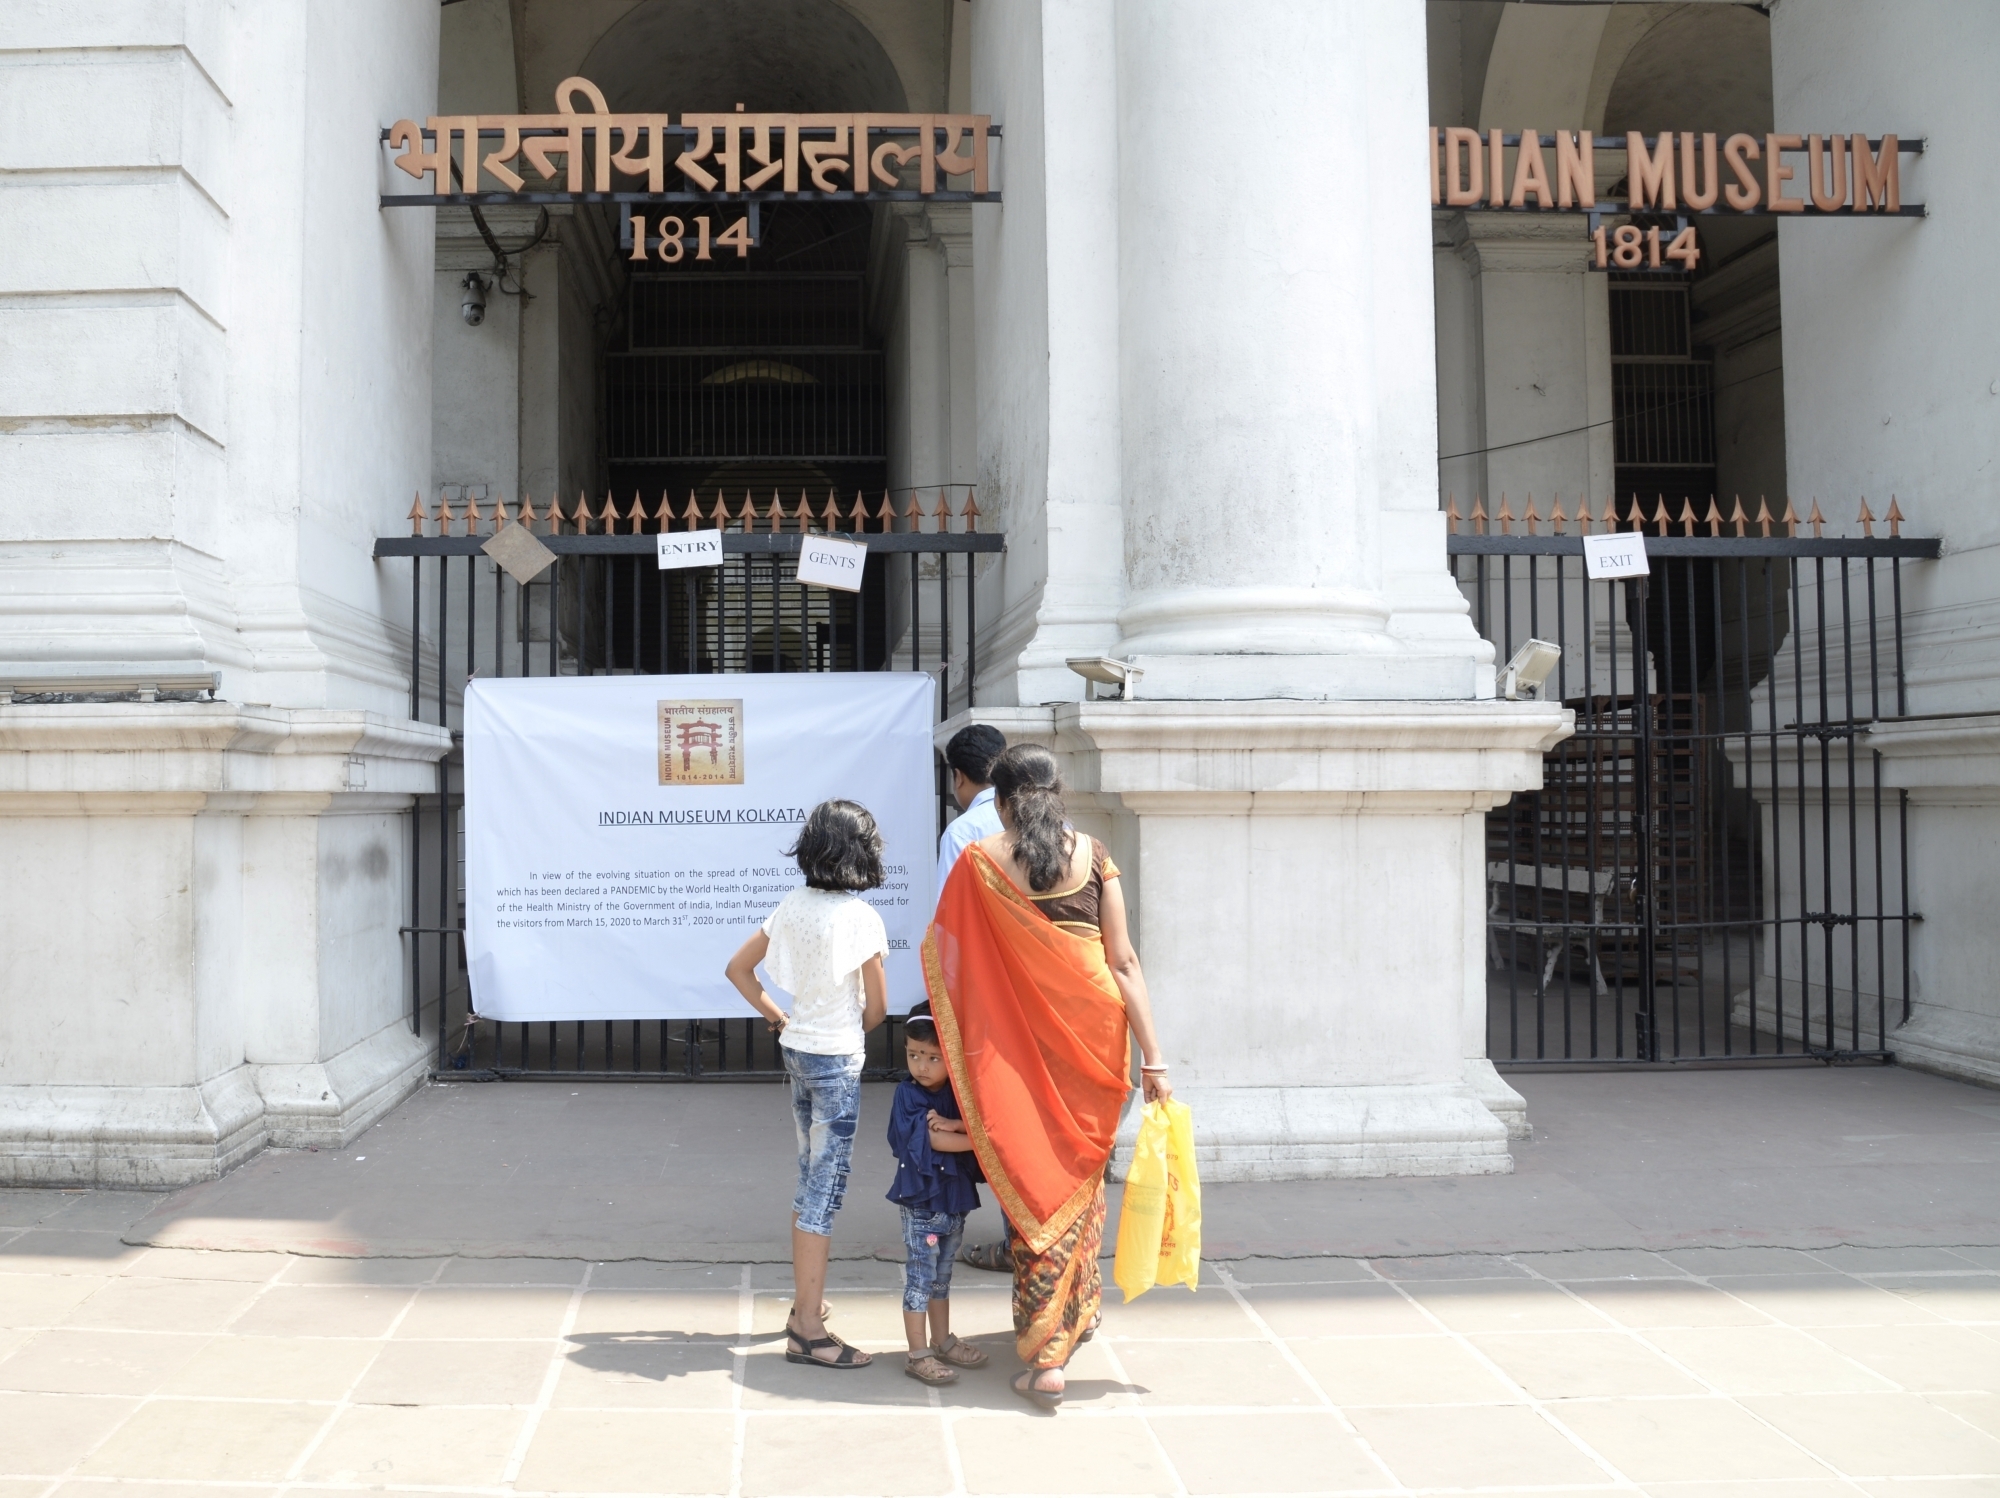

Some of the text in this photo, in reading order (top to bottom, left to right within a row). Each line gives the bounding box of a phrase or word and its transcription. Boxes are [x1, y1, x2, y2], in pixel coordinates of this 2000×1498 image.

[389, 76, 992, 195] भारतीय संग्रहालय
[1429, 126, 1900, 213] DIAN MUSEUM
[628, 215, 754, 263] 1814
[1592, 225, 1700, 270] 1814
[661, 540, 719, 556] ENTRY
[809, 551, 856, 570] GENTS
[1599, 554, 1633, 568] EXIT
[664, 704, 735, 715] भारतीय संग्रहालय
[664, 717, 672, 781] INDIAN MUSEUM
[599, 808, 807, 825] INDIAN MUSEUM KOLKATA
[529, 871, 537, 880] In
[542, 871, 561, 880] view
[565, 871, 574, 879] of
[578, 870, 592, 879] the
[596, 870, 630, 881] evolving
[635, 869, 670, 878] situation
[689, 869, 703, 877] the
[707, 868, 735, 879] spread
[739, 868, 748, 877] of
[752, 868, 780, 876] NOVEL
[784, 866, 804, 876] COR
[883, 865, 909, 875] 2019),
[497, 887, 521, 896] which
[524, 886, 538, 896] has
[541, 886, 561, 895] been
[564, 886, 600, 895] declared
[602, 887, 608, 895] a
[610, 885, 655, 894] PANDEMIC
[657, 885, 667, 896] by
[669, 885, 683, 894] the
[685, 884, 710, 893] World
[713, 884, 740, 893] Health
[742, 883, 795, 895] Organization
[497, 896, 909, 913] of the Health Ministry of the Government of India, Indian Museum closed for
[497, 918, 510, 928] the
[513, 918, 542, 927] visitors
[544, 918, 564, 927] from
[566, 918, 592, 927] March
[595, 917, 607, 928] 15,
[610, 917, 631, 926] 2020
[633, 917, 641, 926] to
[643, 917, 670, 926] March
[693, 916, 713, 925] 2020
[726, 916, 746, 925] until
[887, 939, 910, 949] RDER.
